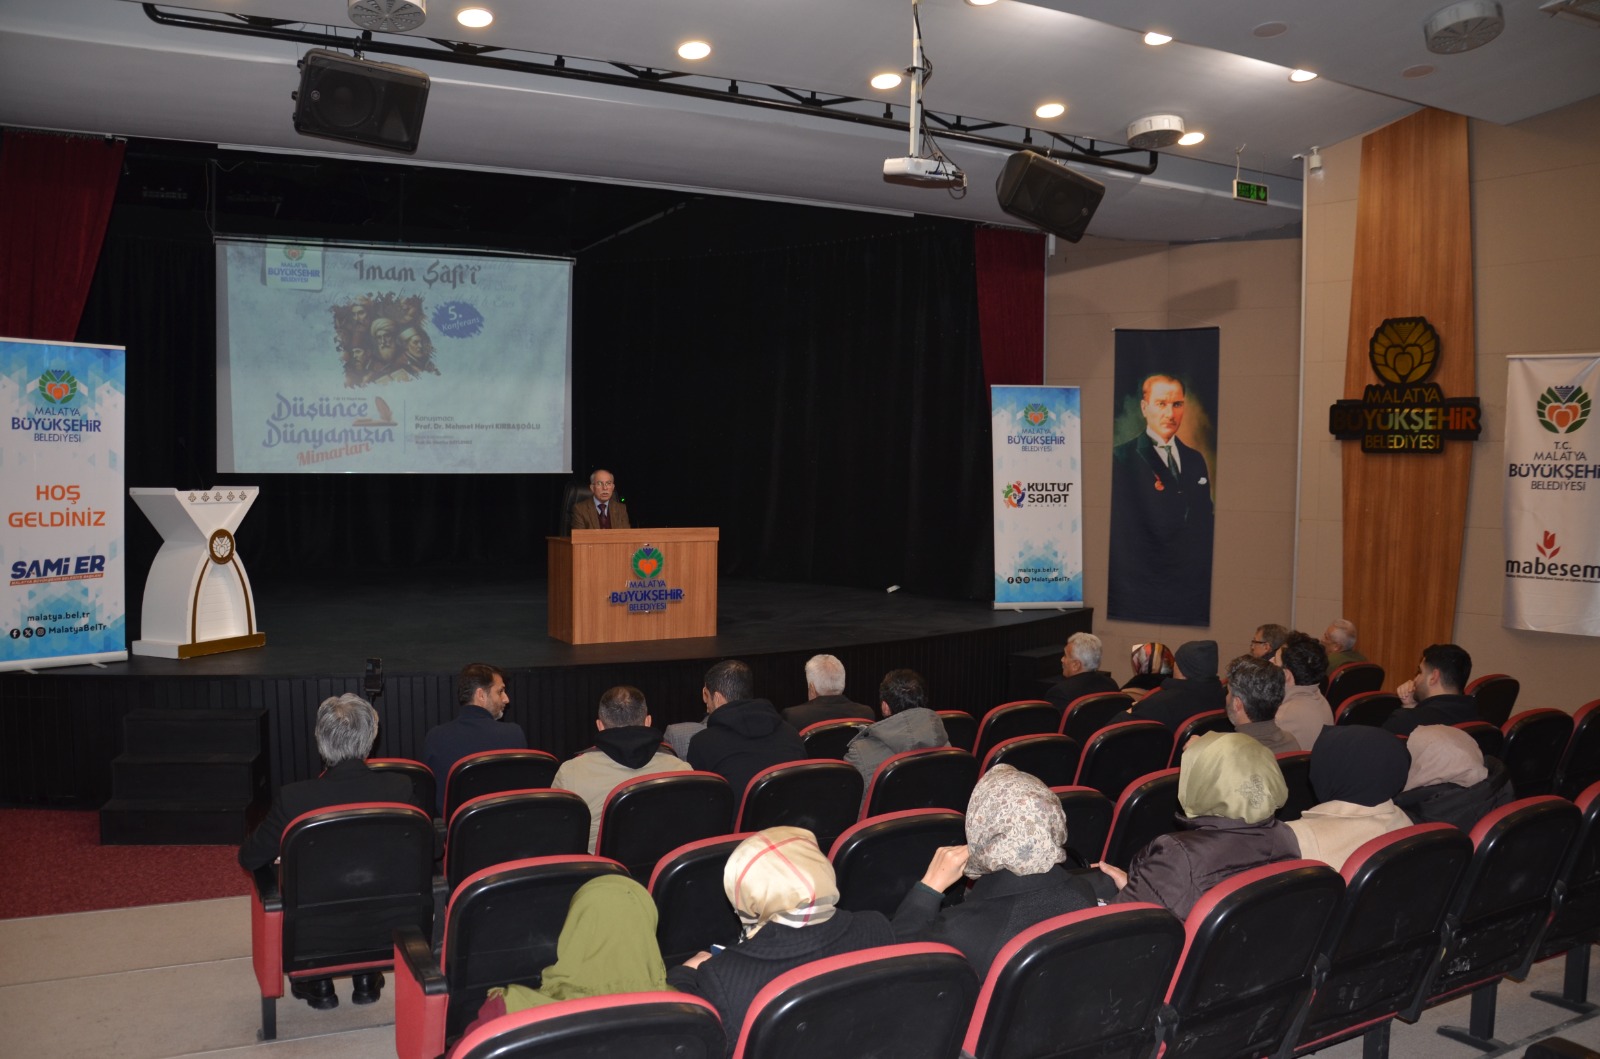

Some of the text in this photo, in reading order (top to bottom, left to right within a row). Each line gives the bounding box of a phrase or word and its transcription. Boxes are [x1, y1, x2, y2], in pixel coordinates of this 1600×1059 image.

[353, 252, 416, 282] İmam
[448, 305, 463, 321] 5.
[1366, 387, 1441, 404] MALATYA
[34, 407, 81, 416] MALATYA
[271, 392, 369, 421] Düşünce
[11, 416, 102, 433] BÜYÜKŞEHİR
[433, 422, 444, 430] Dr.
[444, 422, 474, 430] Mehmet
[1334, 406, 1478, 433] BÜYÜKŞEHİR
[33, 432, 82, 443] BELEDİYESİ
[262, 419, 395, 450] Dünyamızın
[1007, 435, 1066, 446] BÜYÜKŞEHİR
[1365, 433, 1441, 449] BELEDİYESİ
[296, 441, 372, 466] Mimarları
[1554, 441, 1572, 450] T.C.
[1533, 451, 1588, 461] MALATYA
[1530, 480, 1587, 491] BELEDİYESİ
[35, 484, 81, 505] HOŞ
[7, 507, 106, 528] GELDİNİZ
[10, 554, 106, 580] SAMİ ER
[1505, 556, 1600, 579] mabesem
[629, 579, 666, 588] MALATYA
[1031, 576, 1071, 584] MalatyaBelTr
[611, 588, 683, 604] BÜYÜKŞEHİR
[628, 602, 667, 612] BELEDİYESİ
[26, 611, 91, 622] malatya.bel.tr
[48, 623, 107, 634] MalatyaBelTr
